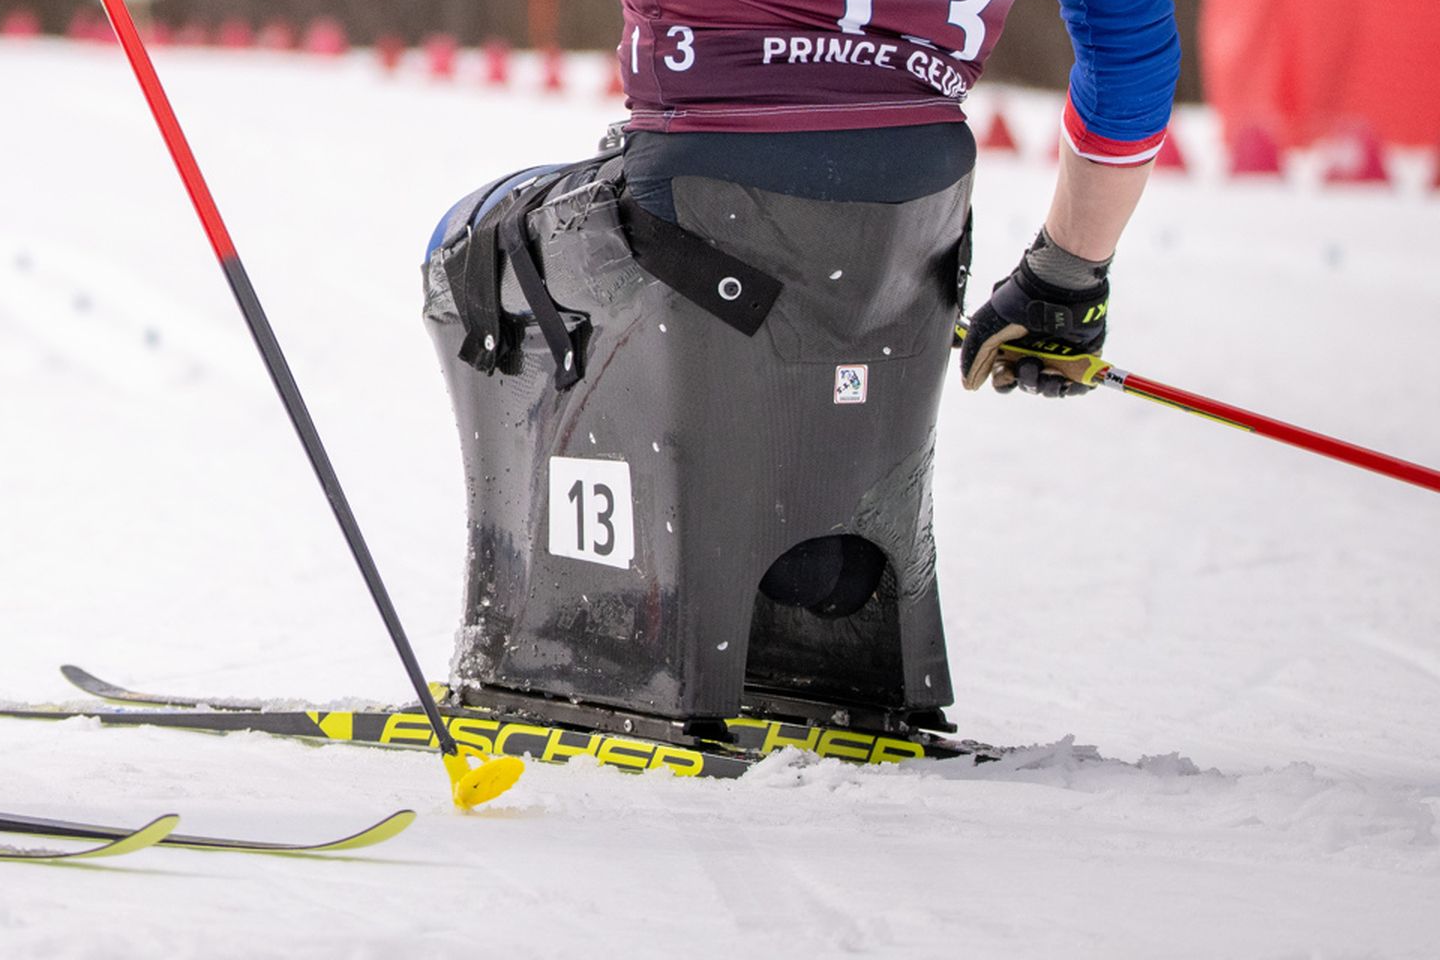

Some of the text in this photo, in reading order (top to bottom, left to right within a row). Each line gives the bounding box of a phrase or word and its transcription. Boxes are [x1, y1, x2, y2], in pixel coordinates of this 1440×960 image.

[762, 38, 968, 98] PRINCE GEO
[567, 479, 615, 557] 13
